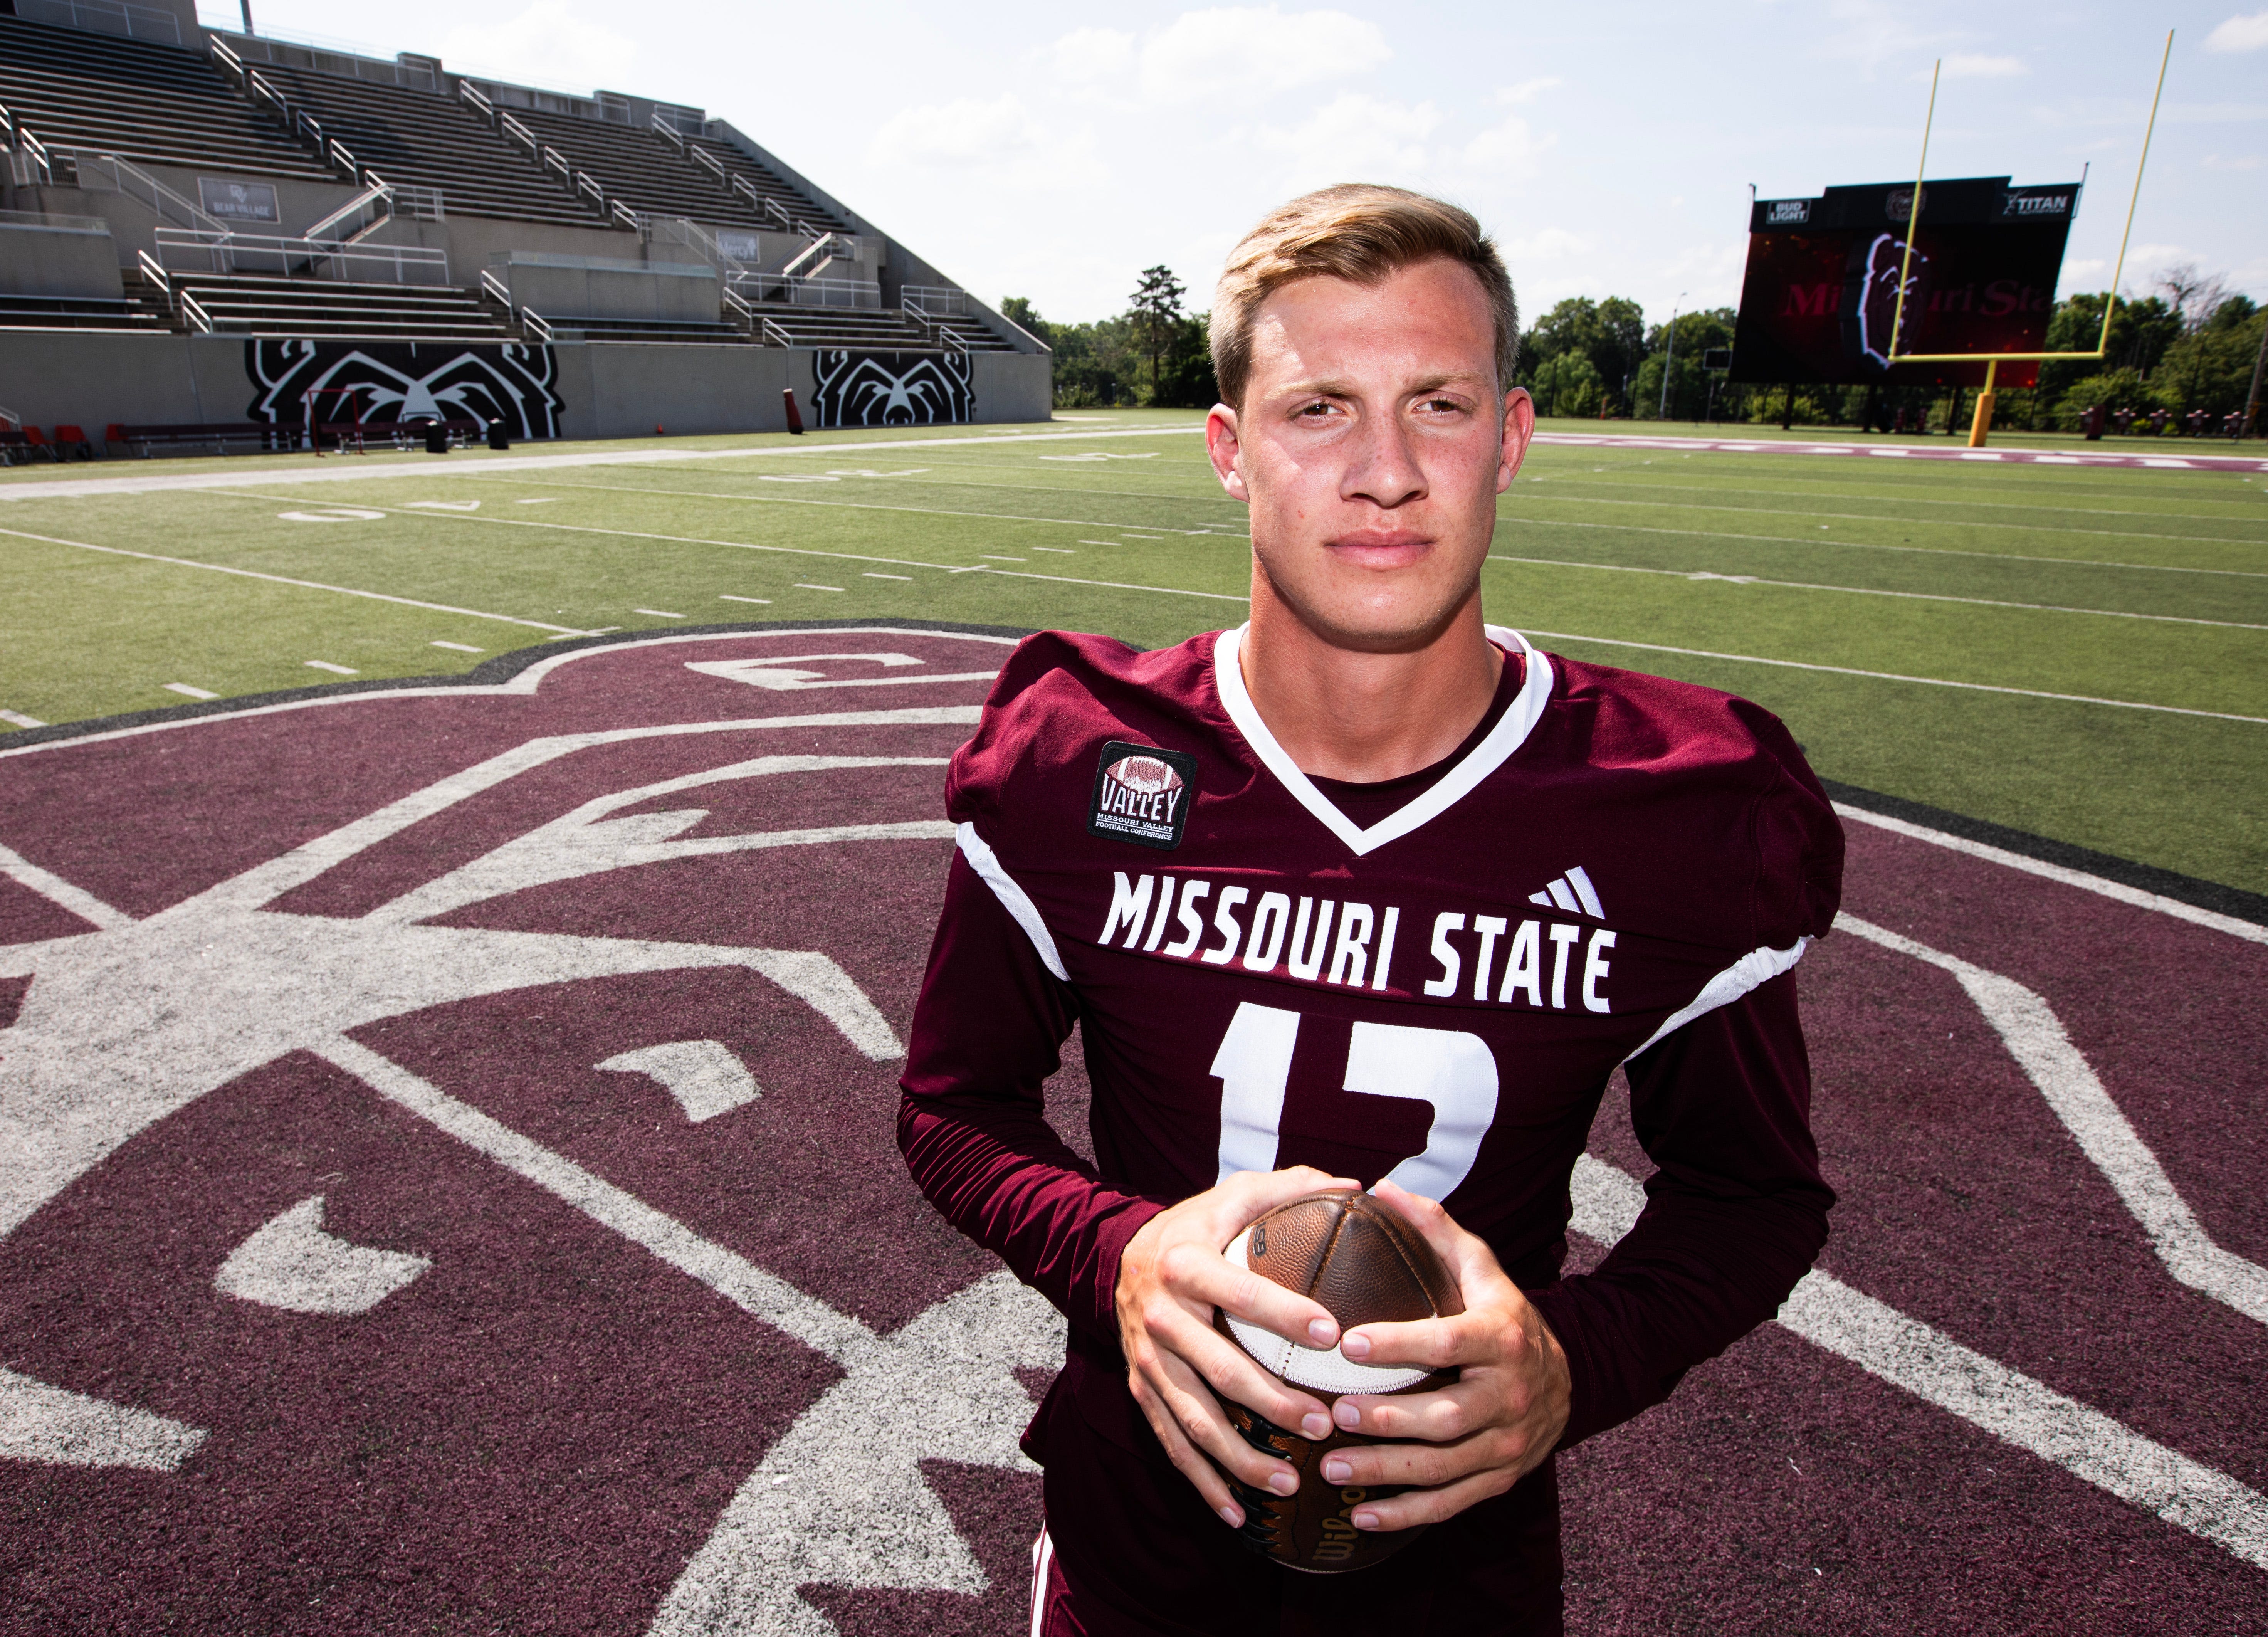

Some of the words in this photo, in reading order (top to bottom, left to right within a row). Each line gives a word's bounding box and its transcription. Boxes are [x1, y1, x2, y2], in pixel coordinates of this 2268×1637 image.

[213, 202, 237, 212] BEAR
[1776, 201, 1802, 212] BUD
[2018, 195, 2068, 210] TITAN
[1770, 210, 1806, 221] LIGHT
[718, 240, 749, 259] Mercy
[1101, 773, 1183, 823] VALLEY
[1096, 813, 1139, 826] MISSOURI
[1142, 822, 1174, 832] VALLEY
[1096, 821, 1129, 832] FOOTBALL
[1130, 828, 1172, 840] CONFERENCE
[1098, 872, 1400, 992] MISSOURI
[1424, 912, 1617, 1013] STATE
